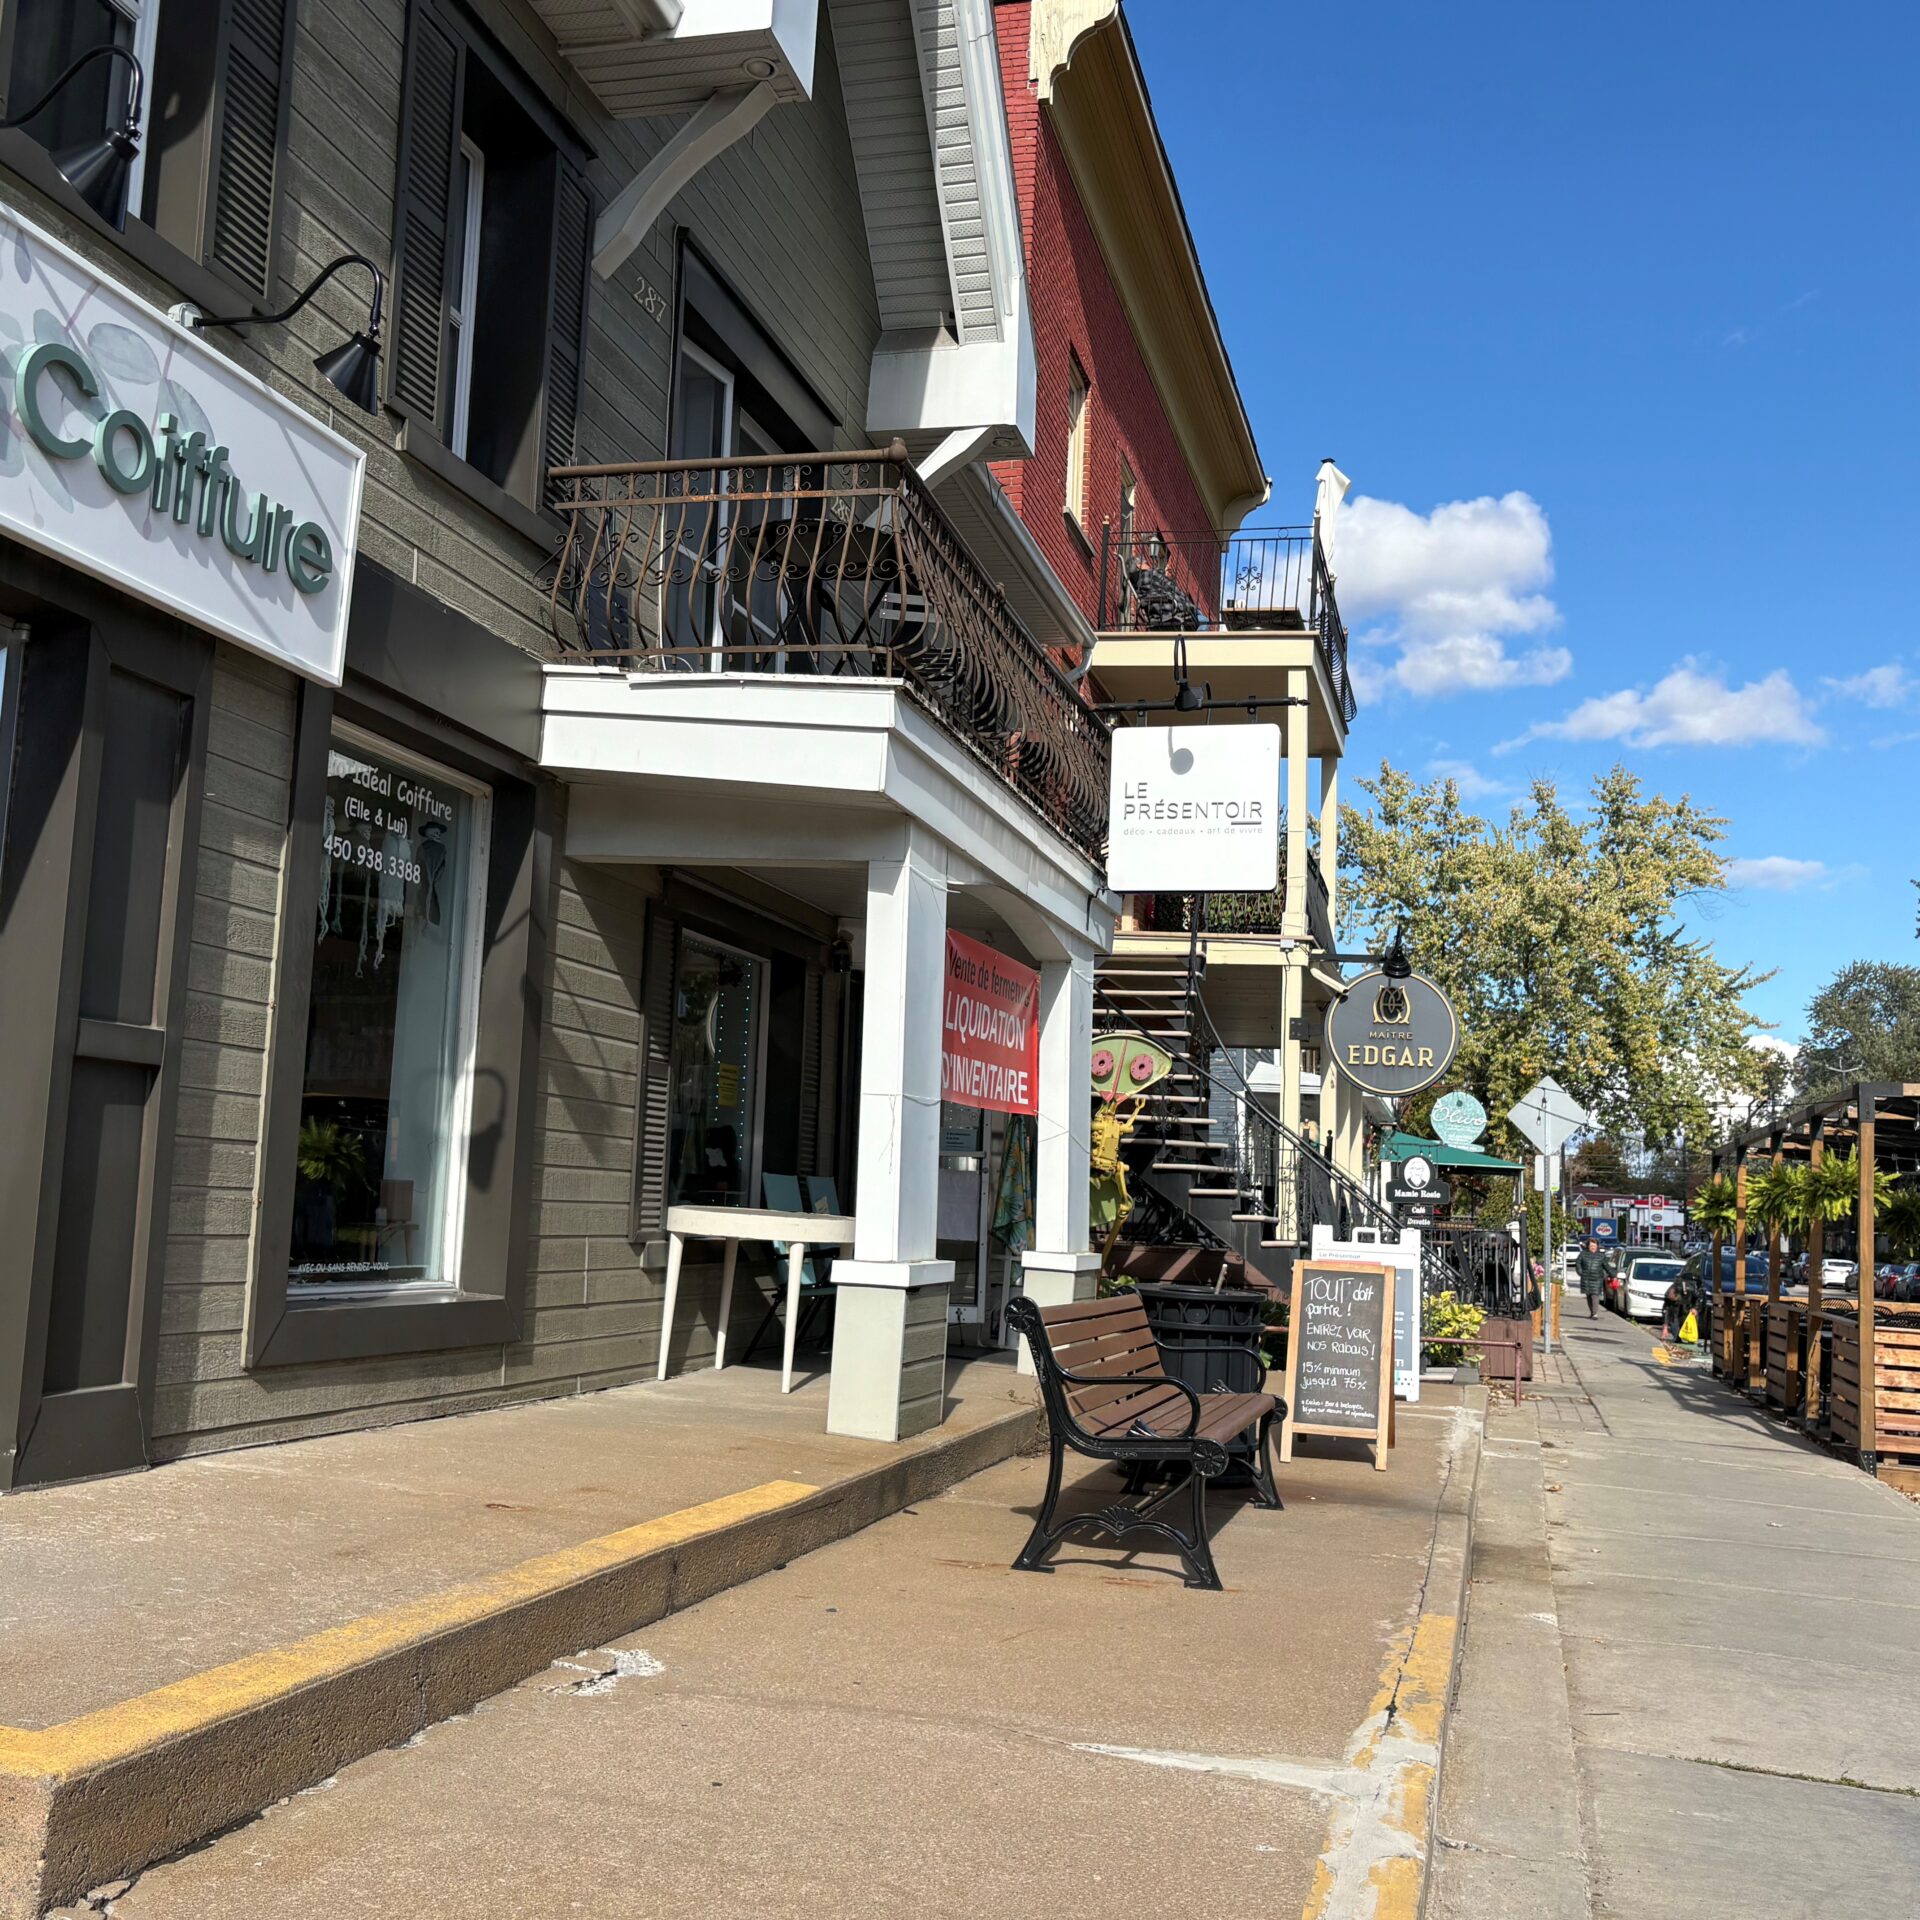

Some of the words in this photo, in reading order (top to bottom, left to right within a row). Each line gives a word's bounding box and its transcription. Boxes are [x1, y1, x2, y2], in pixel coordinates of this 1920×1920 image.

[633, 276, 667, 322] 287
[16, 342, 333, 594] Coiffure
[352, 765, 392, 797] Idéal
[397, 780, 453, 822] Coiffure
[1124, 782, 1148, 799] LE
[344, 796, 370, 821] (Elle
[375, 808, 383, 827] &
[387, 812, 408, 838] Lui)
[1123, 799, 1262, 820] PRÉSENTOIR
[1123, 827, 1146, 836] déco
[1156, 826, 1196, 836] cadeaux
[324, 834, 421, 884] 450.938.3388
[948, 946, 976, 985] Vente
[978, 959, 989, 990] de
[990, 965, 1031, 1009] fermeture
[945, 991, 1026, 1051] LIQUIDATION
[1369, 1028, 1414, 1040] MAÎTRE
[1347, 1044, 1434, 1068] EDGAR
[942, 1052, 1029, 1105] D'INVENTAIRE
[1411, 1206, 1426, 1214] Café
[297, 1263, 314, 1273] AVEC
[315, 1263, 326, 1273] OU
[327, 1263, 345, 1273] SANS
[346, 1261, 390, 1272] RENDEZ-VOUS
[1304, 1276, 1355, 1304] TOUT
[1352, 1281, 1374, 1301] doit
[1307, 1340, 1327, 1351] NOS
[1302, 1361, 1322, 1374] 15%
[1344, 1377, 1367, 1390] 75%
